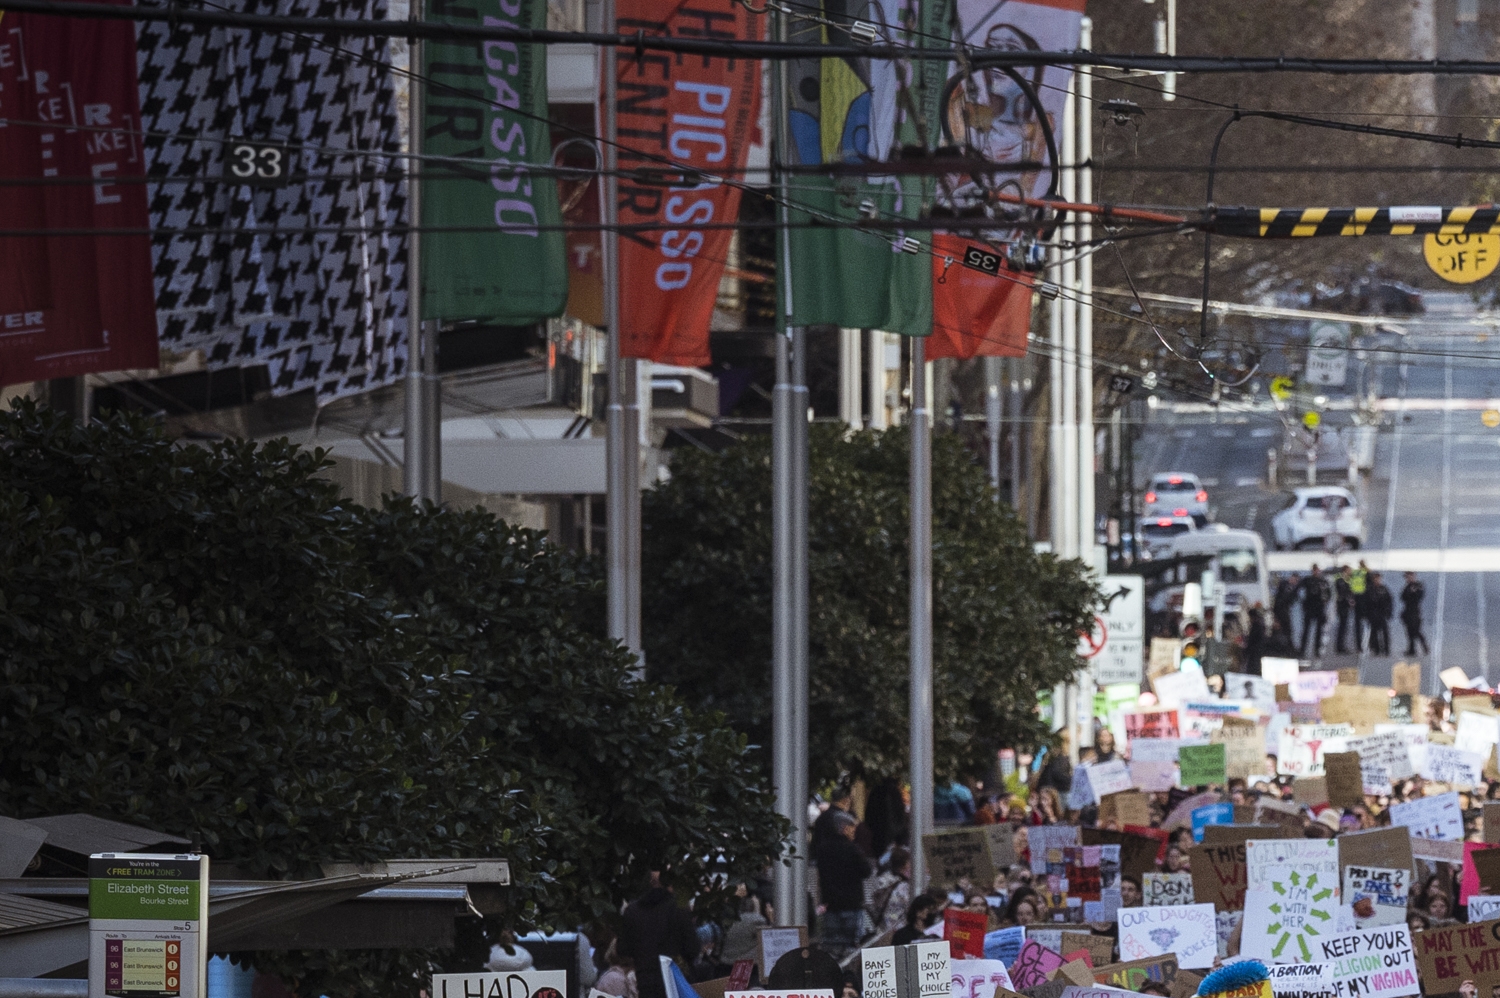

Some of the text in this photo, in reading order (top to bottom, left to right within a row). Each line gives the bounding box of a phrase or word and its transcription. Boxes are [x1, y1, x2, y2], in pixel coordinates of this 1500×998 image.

[232, 145, 283, 179] 33
[968, 250, 997, 271] 35
[108, 883, 189, 895] Elizabeth Street
[140, 897, 165, 905] Bourke
[185, 922, 191, 930] 5
[1321, 931, 1406, 959] KEEP YOUR
[1422, 931, 1452, 954] MAY
[1459, 926, 1485, 946] THE
[865, 959, 891, 970] BANS
[1384, 950, 1411, 968] OUT
[868, 970, 886, 980] OFF
[1434, 956, 1460, 979] BE
[867, 980, 888, 989] OUR
[920, 982, 951, 993] CHOICE
[1371, 969, 1416, 991] VAGINA
